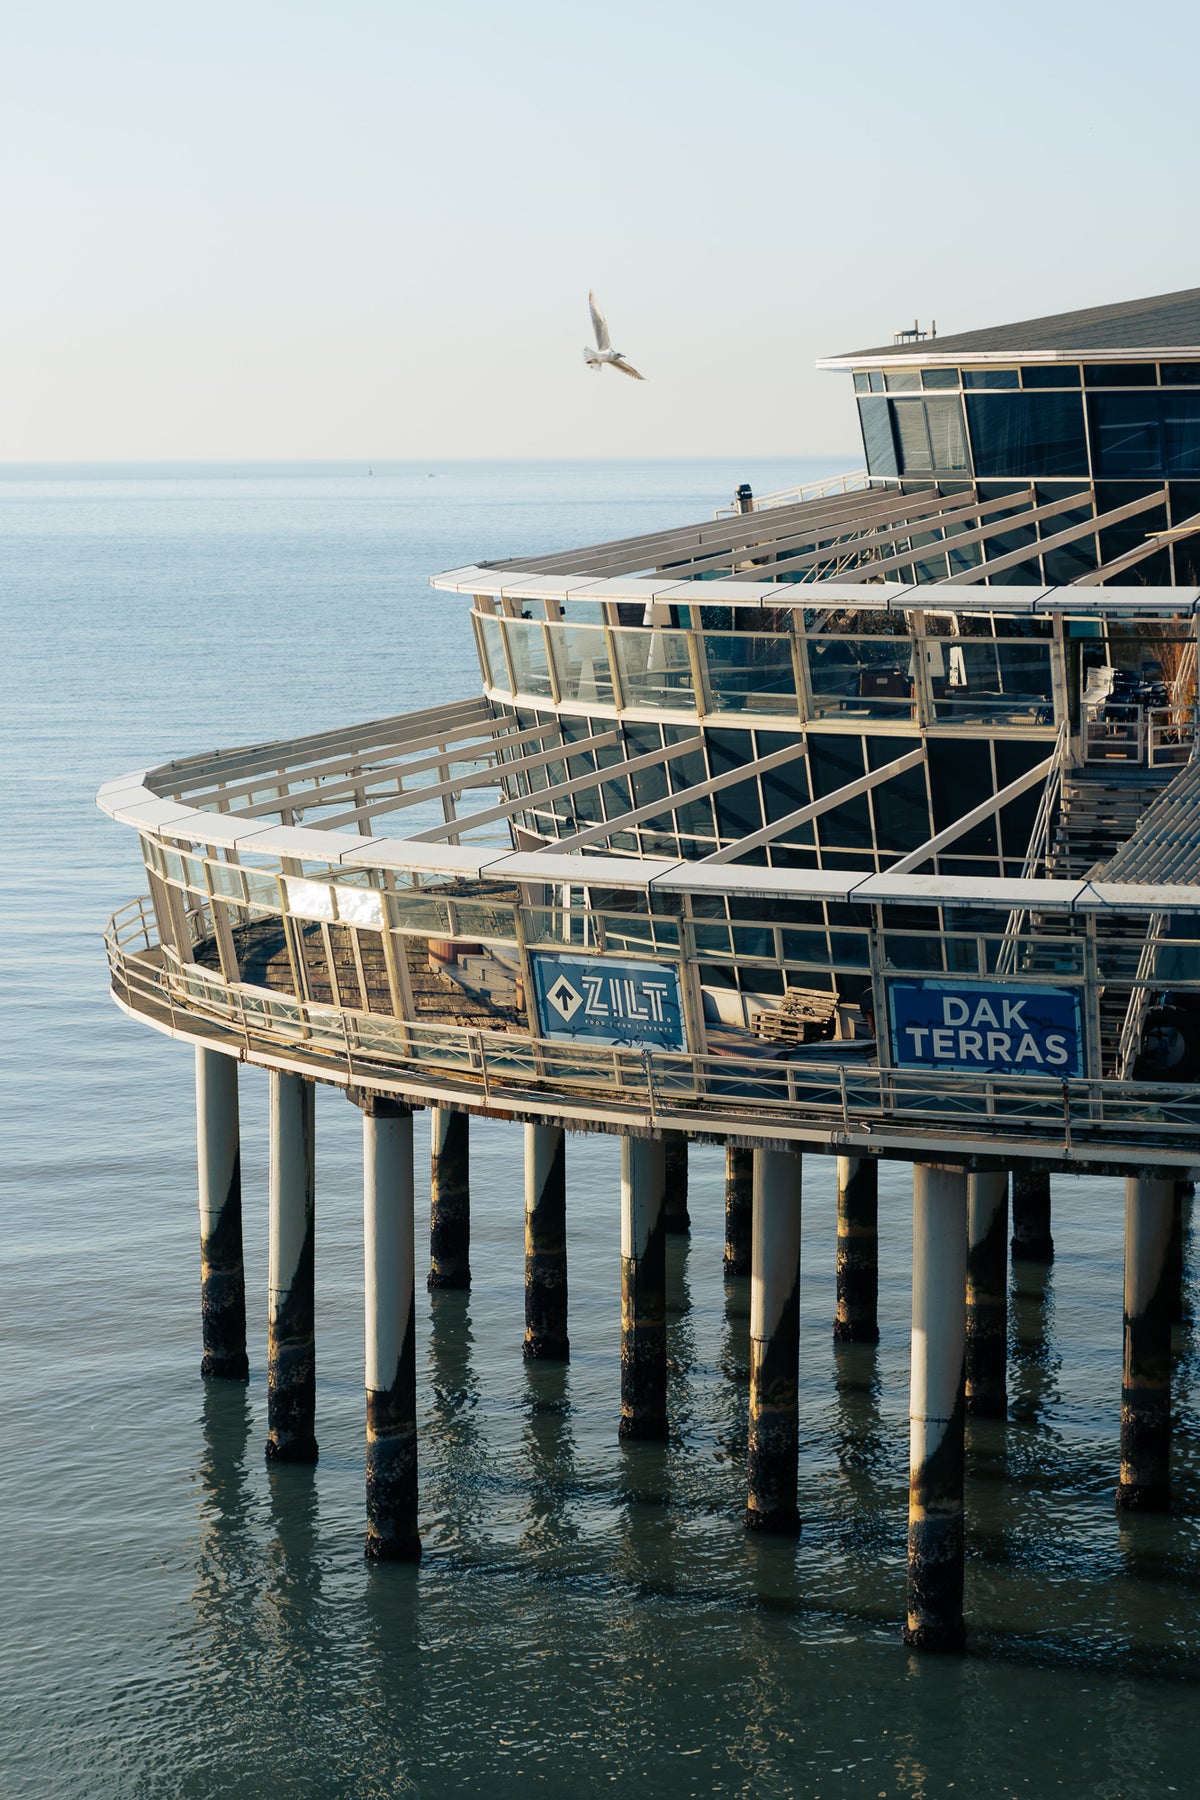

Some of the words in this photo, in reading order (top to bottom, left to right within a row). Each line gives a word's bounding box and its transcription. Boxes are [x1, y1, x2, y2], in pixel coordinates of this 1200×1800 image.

[643, 1025, 673, 1033] EVENTS
[942, 996, 1029, 1030] DAK
[905, 1027, 1069, 1065] TERRAS
